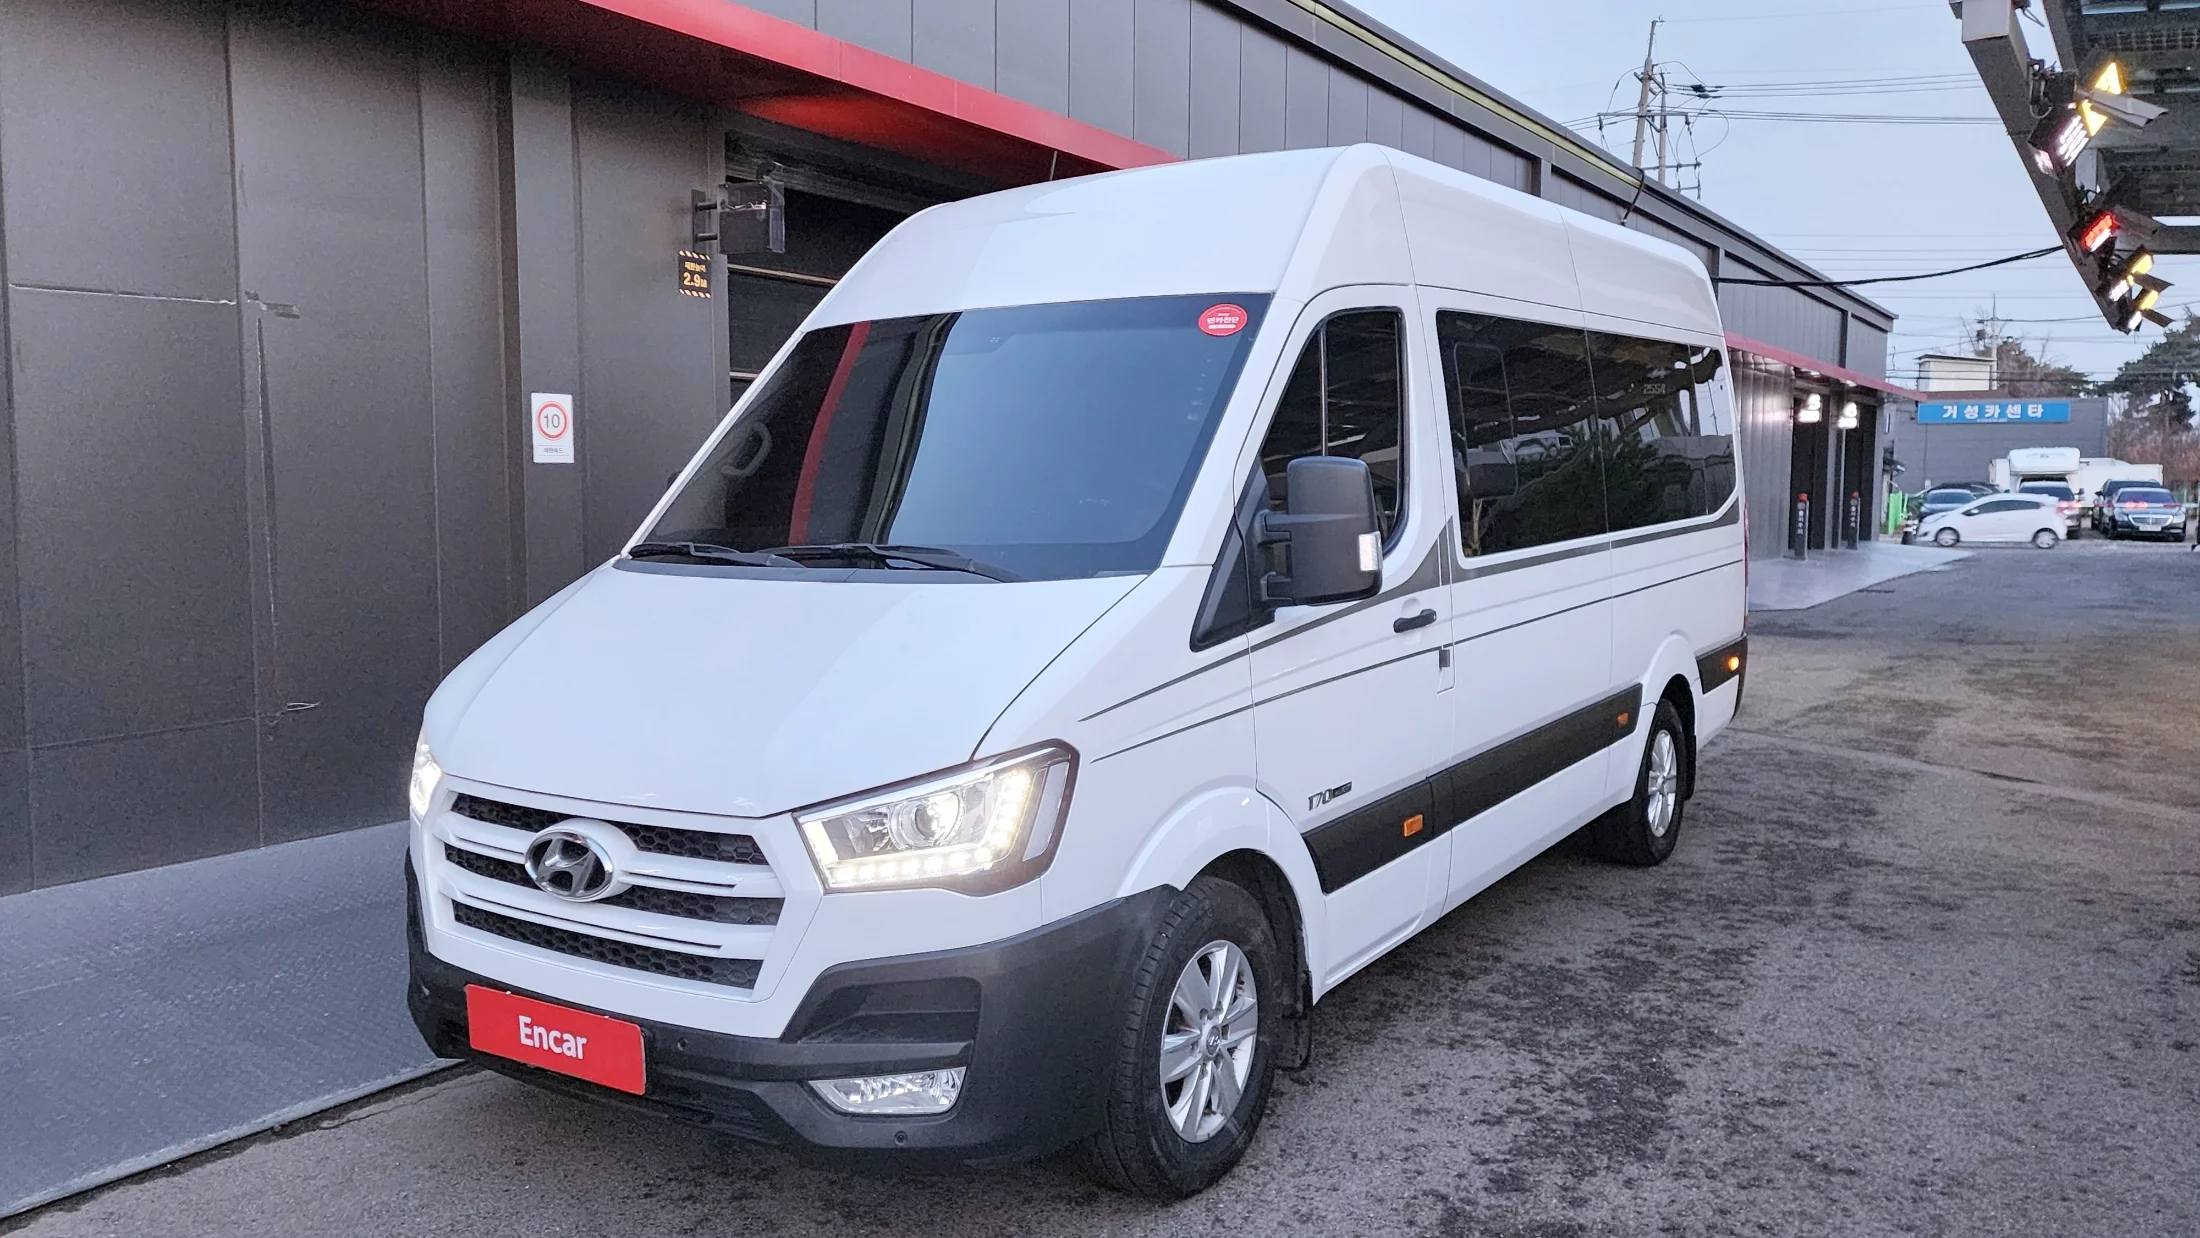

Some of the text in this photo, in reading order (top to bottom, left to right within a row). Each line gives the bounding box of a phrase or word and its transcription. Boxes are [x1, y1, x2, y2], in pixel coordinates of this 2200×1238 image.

[1942, 403, 2044, 420] 거성카센타
[543, 413, 561, 429] 10
[518, 1014, 588, 1060] Encar
